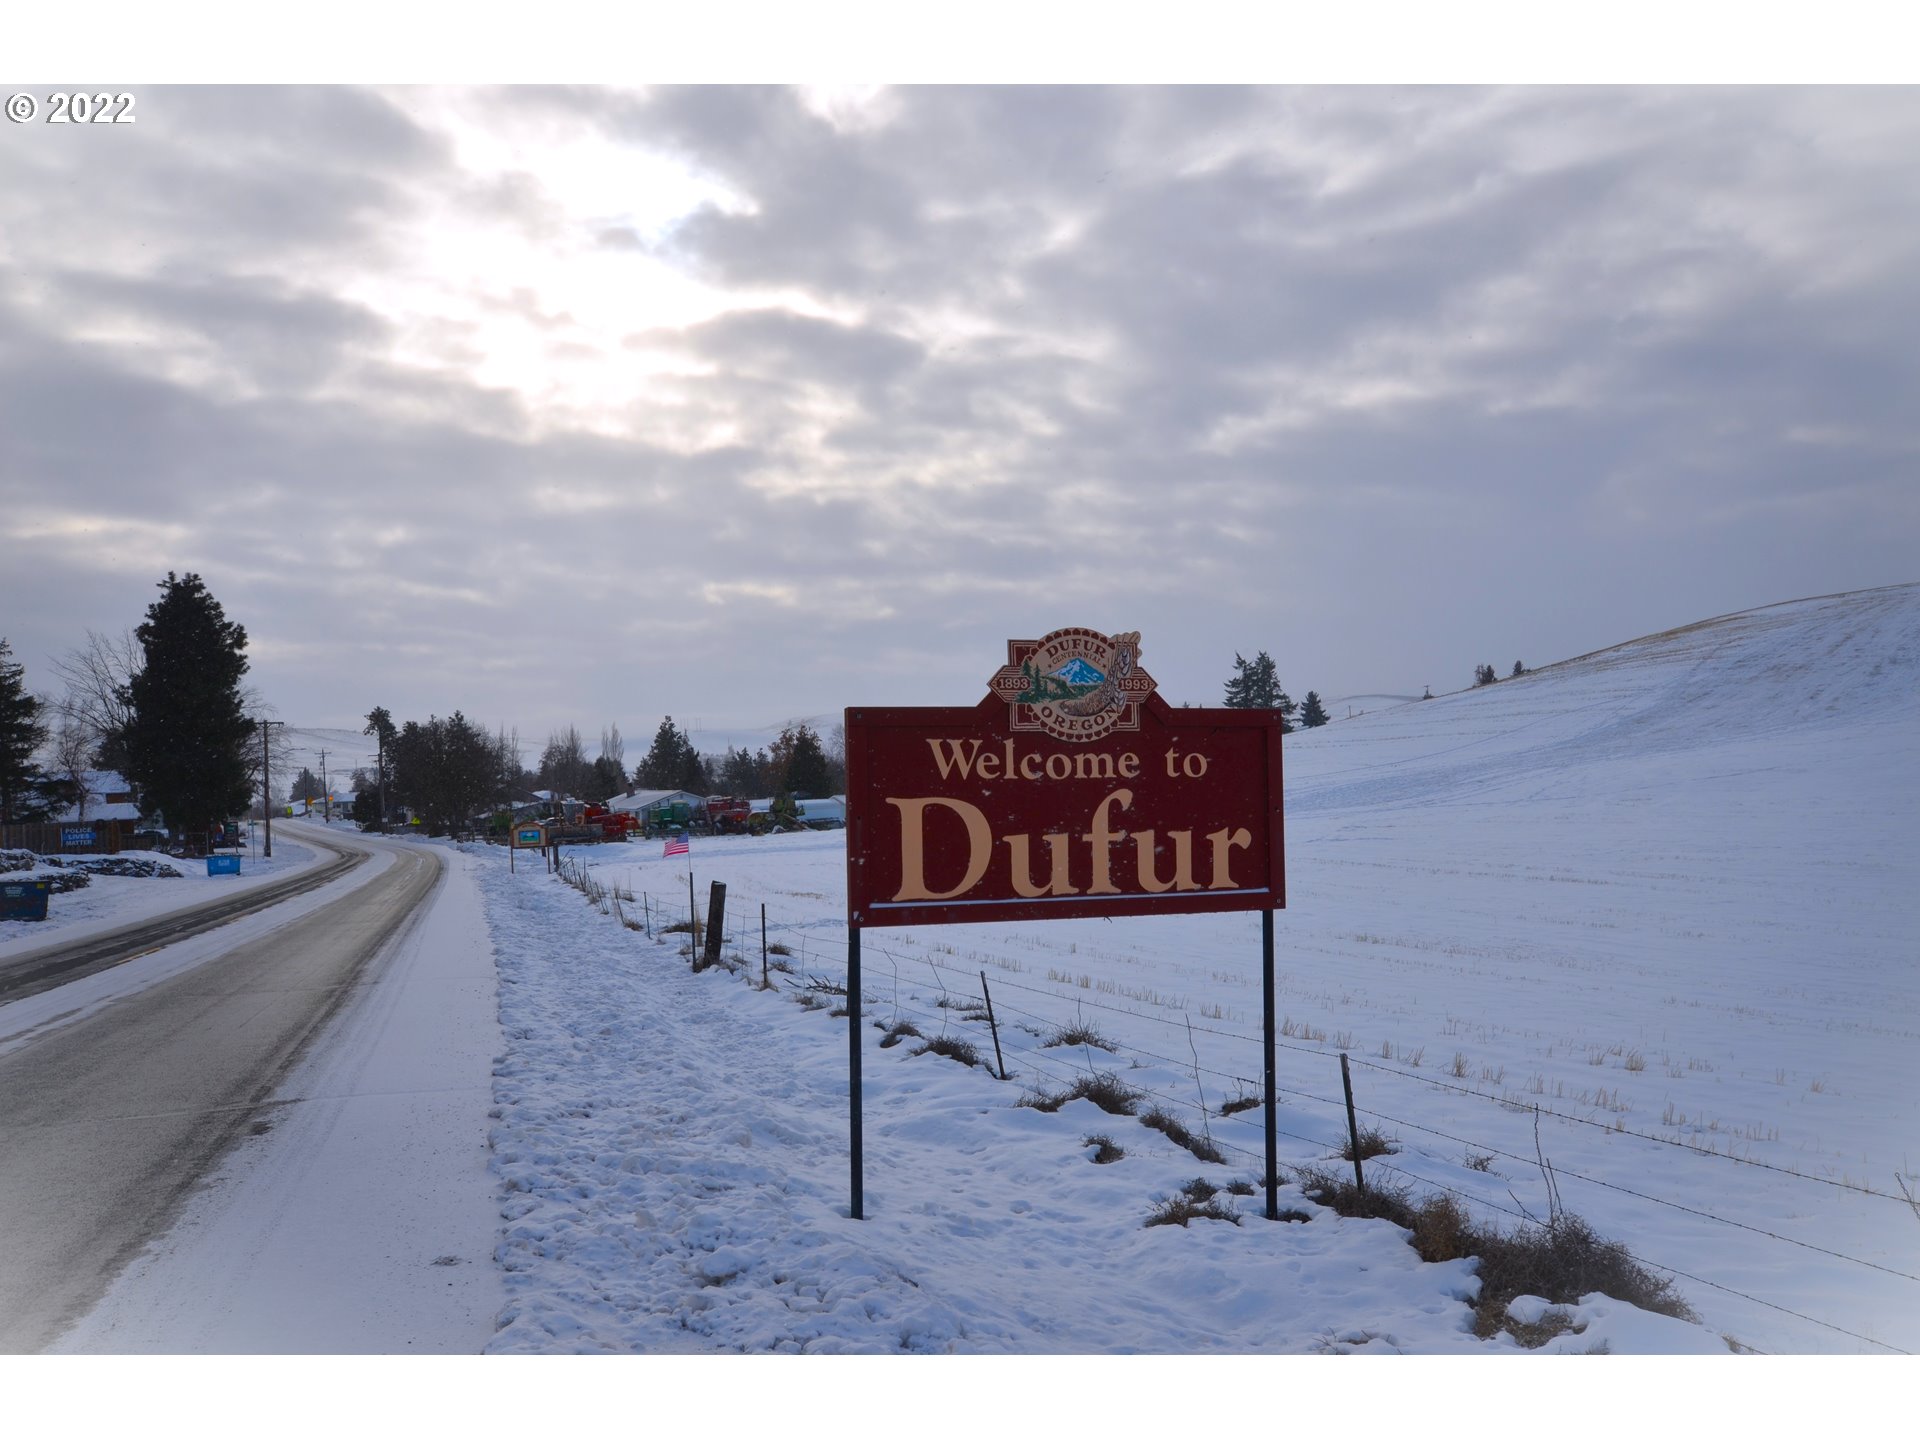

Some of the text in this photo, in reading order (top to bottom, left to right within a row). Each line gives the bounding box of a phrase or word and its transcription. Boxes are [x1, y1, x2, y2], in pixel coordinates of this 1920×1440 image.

[1045, 639, 1107, 659] DUFUR
[1052, 650, 1101, 665] CENTENNIAL
[1000, 678, 1029, 689] 1893
[1120, 679, 1149, 690] 1993
[1041, 705, 1116, 731] OREGON
[926, 738, 1208, 781] Welcome to
[885, 788, 1252, 902] Dufur
